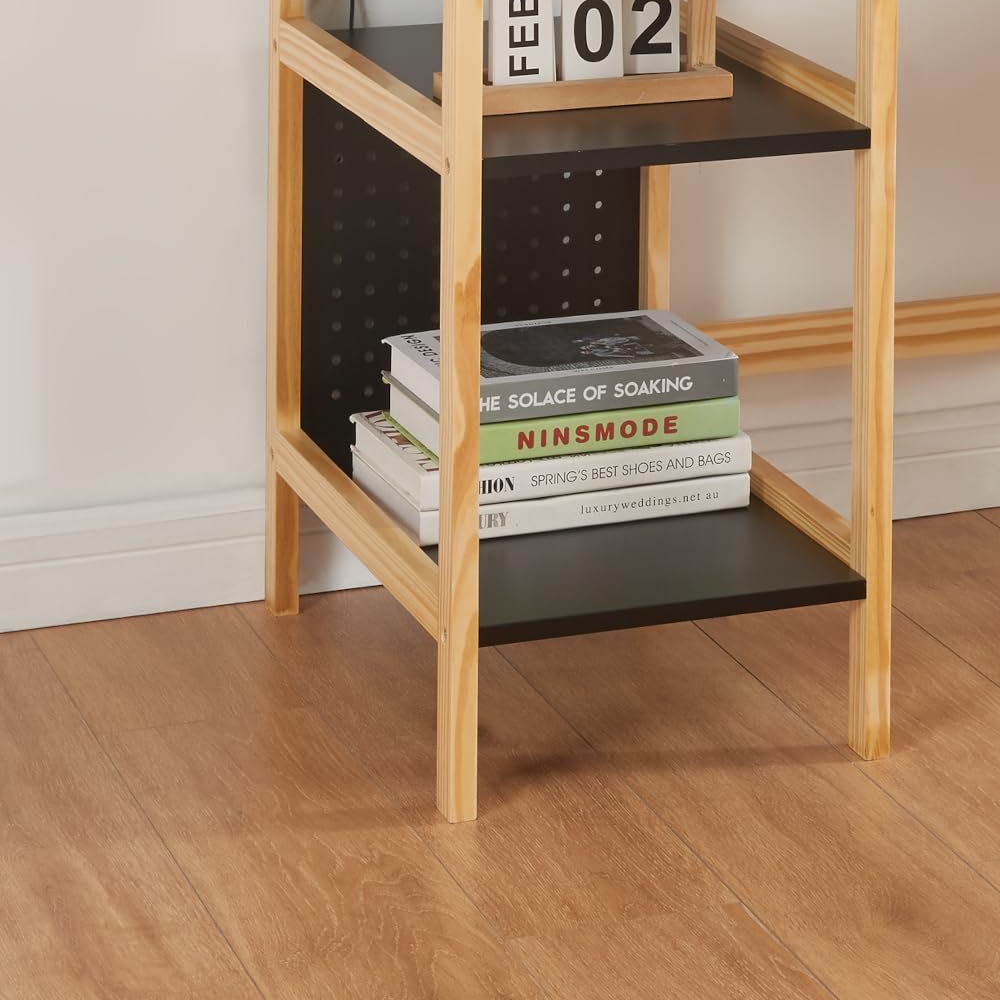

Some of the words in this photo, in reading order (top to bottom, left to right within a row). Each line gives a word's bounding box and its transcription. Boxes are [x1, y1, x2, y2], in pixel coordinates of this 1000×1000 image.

[400, 334, 439, 357] DESIGN
[480, 395, 501, 413] HE
[507, 388, 577, 409] SOLACE
[583, 384, 607, 401] OF
[613, 375, 694, 399] SOAKING
[517, 415, 679, 450] NINSMODE
[478, 476, 515, 495] HION
[530, 469, 588, 487] SPRING'S
[591, 466, 619, 480] BEST
[622, 460, 663, 476] SHOES
[665, 456, 695, 471] AND
[698, 451, 732, 467] BAGS
[478, 511, 509, 530] URY
